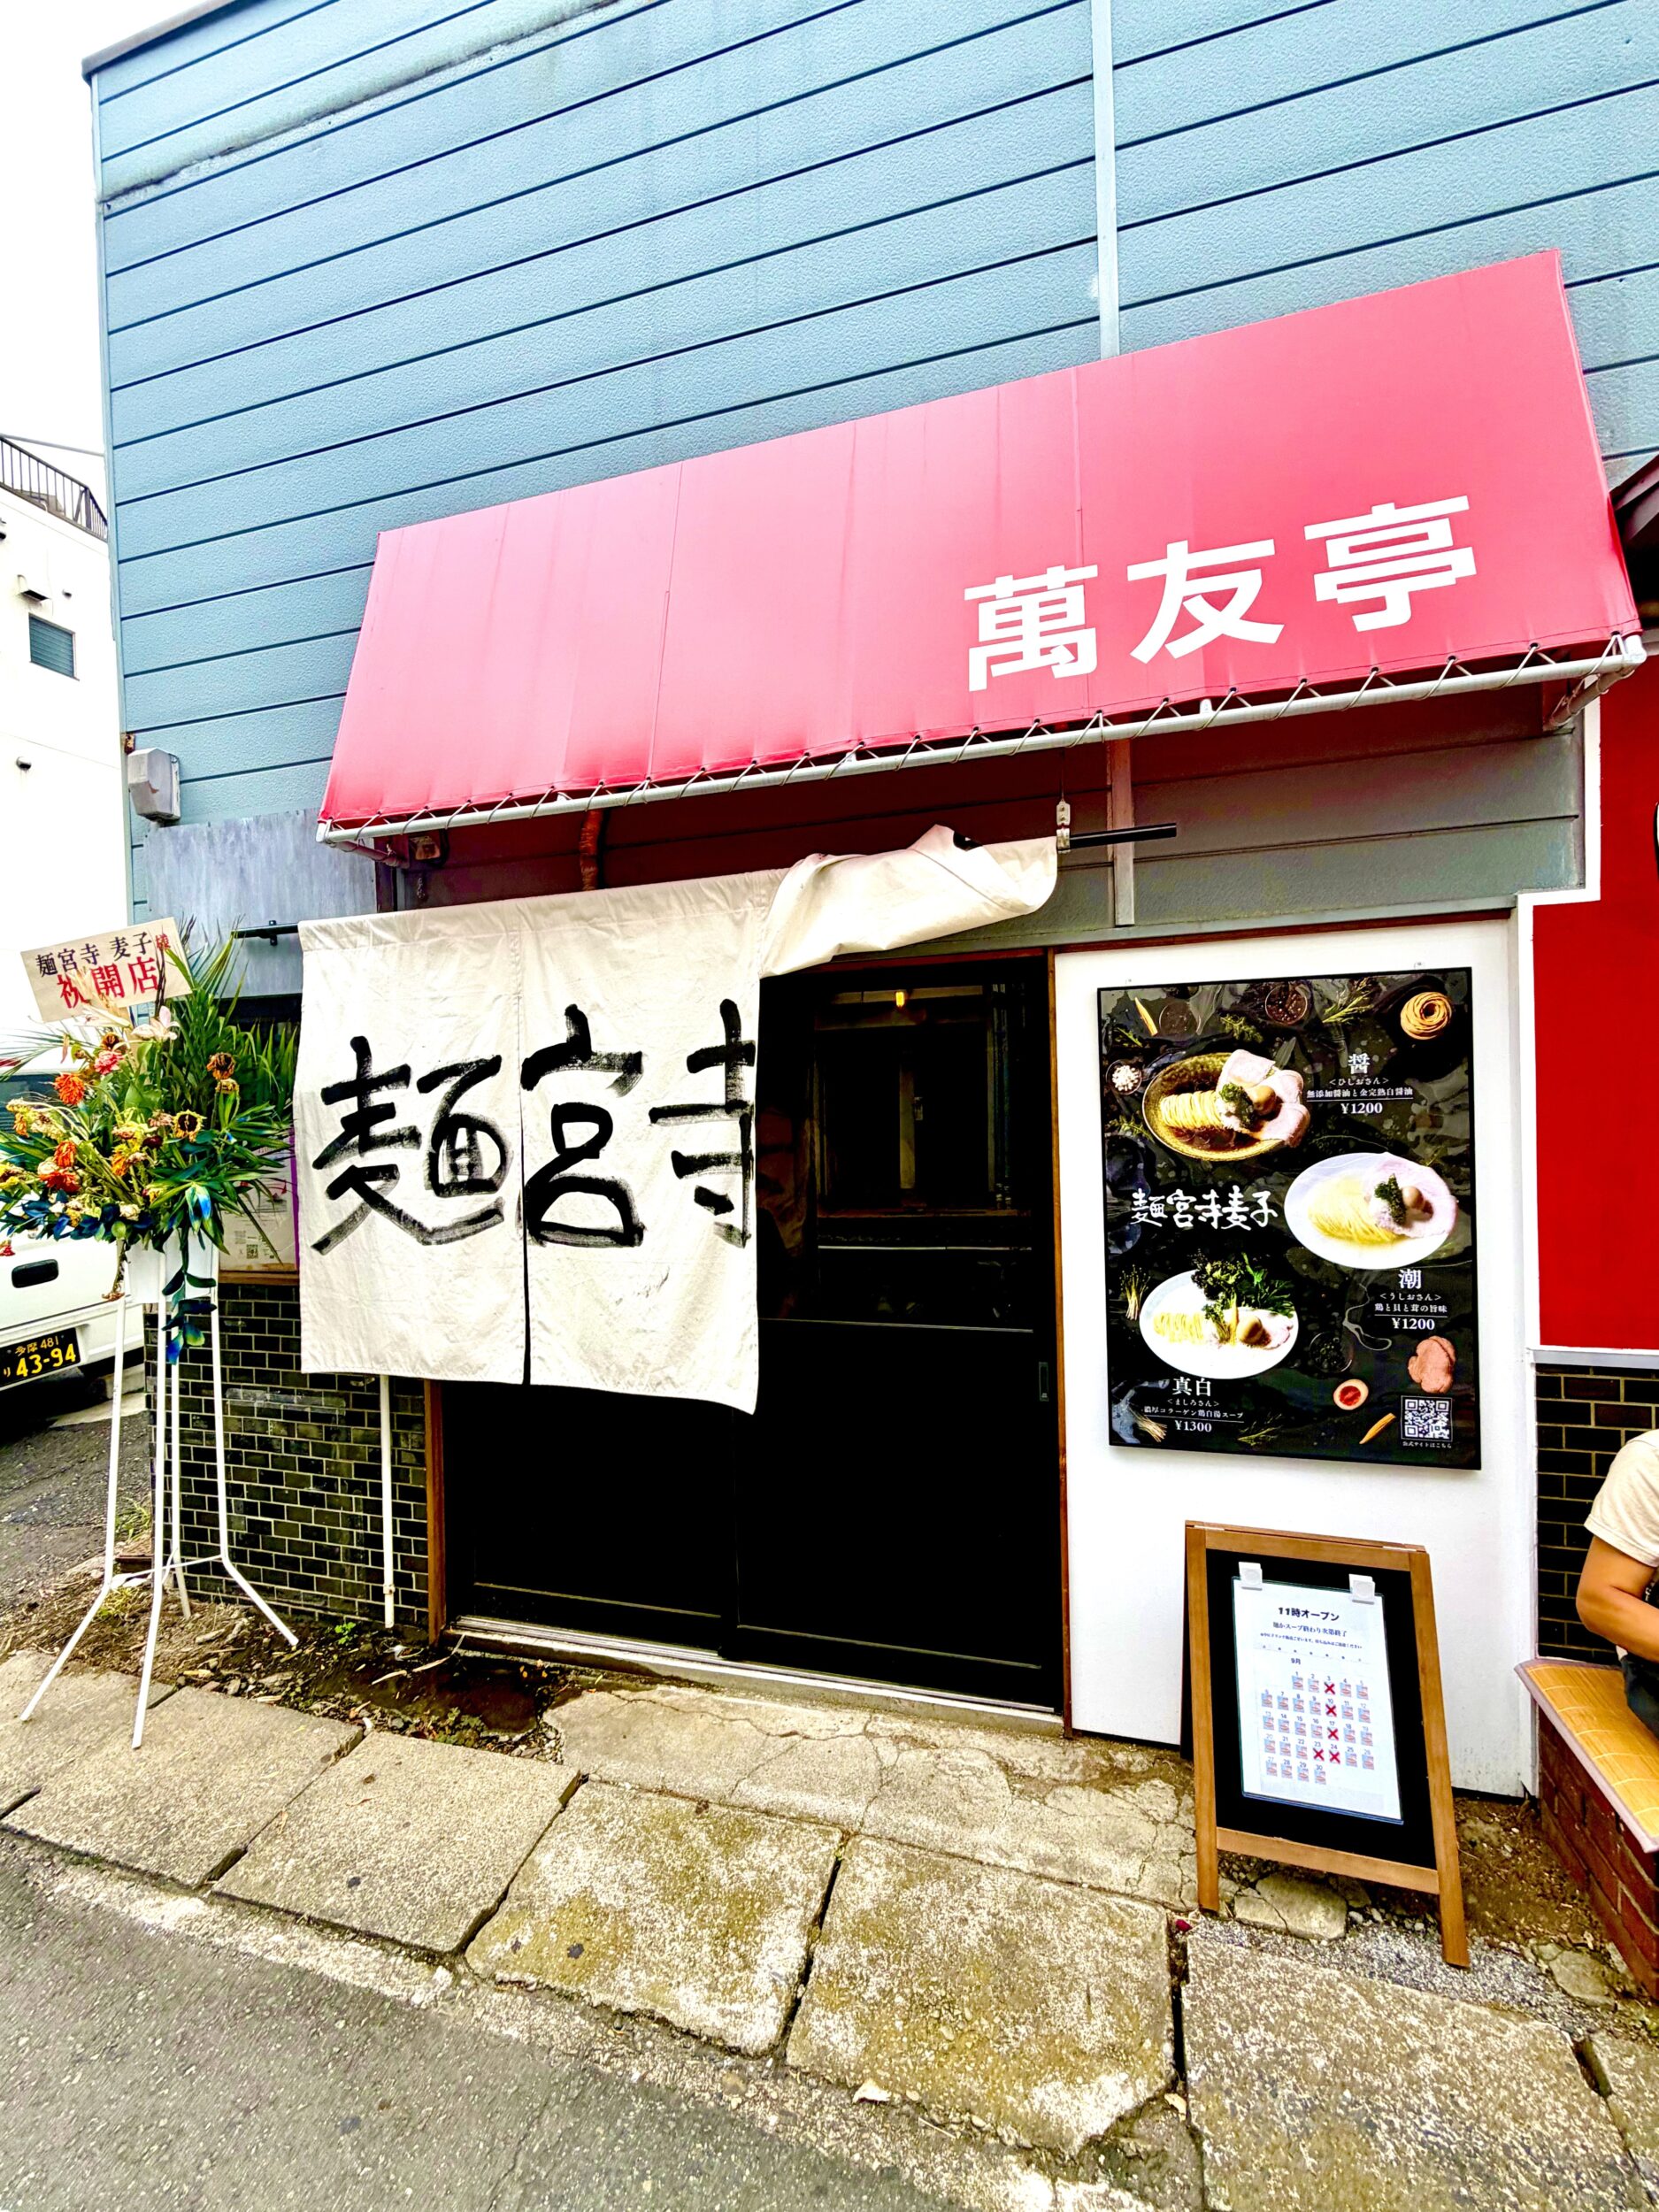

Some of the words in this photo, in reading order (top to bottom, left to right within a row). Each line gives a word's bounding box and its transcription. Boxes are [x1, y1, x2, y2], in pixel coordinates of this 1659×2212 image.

[964, 495, 1477, 691] 萬友亭
[1340, 1102, 1383, 1114] ¥1200
[1398, 1268, 1422, 1289] 潮
[1392, 1317, 1435, 1330] ¥1200
[40, 1335, 59, 1349] 481
[16, 1343, 76, 1378] 43-94
[1172, 1376, 1211, 1396] 真白
[1175, 1419, 1212, 1432] ¥1300
[1279, 1607, 1340, 1621] 11時オープン
